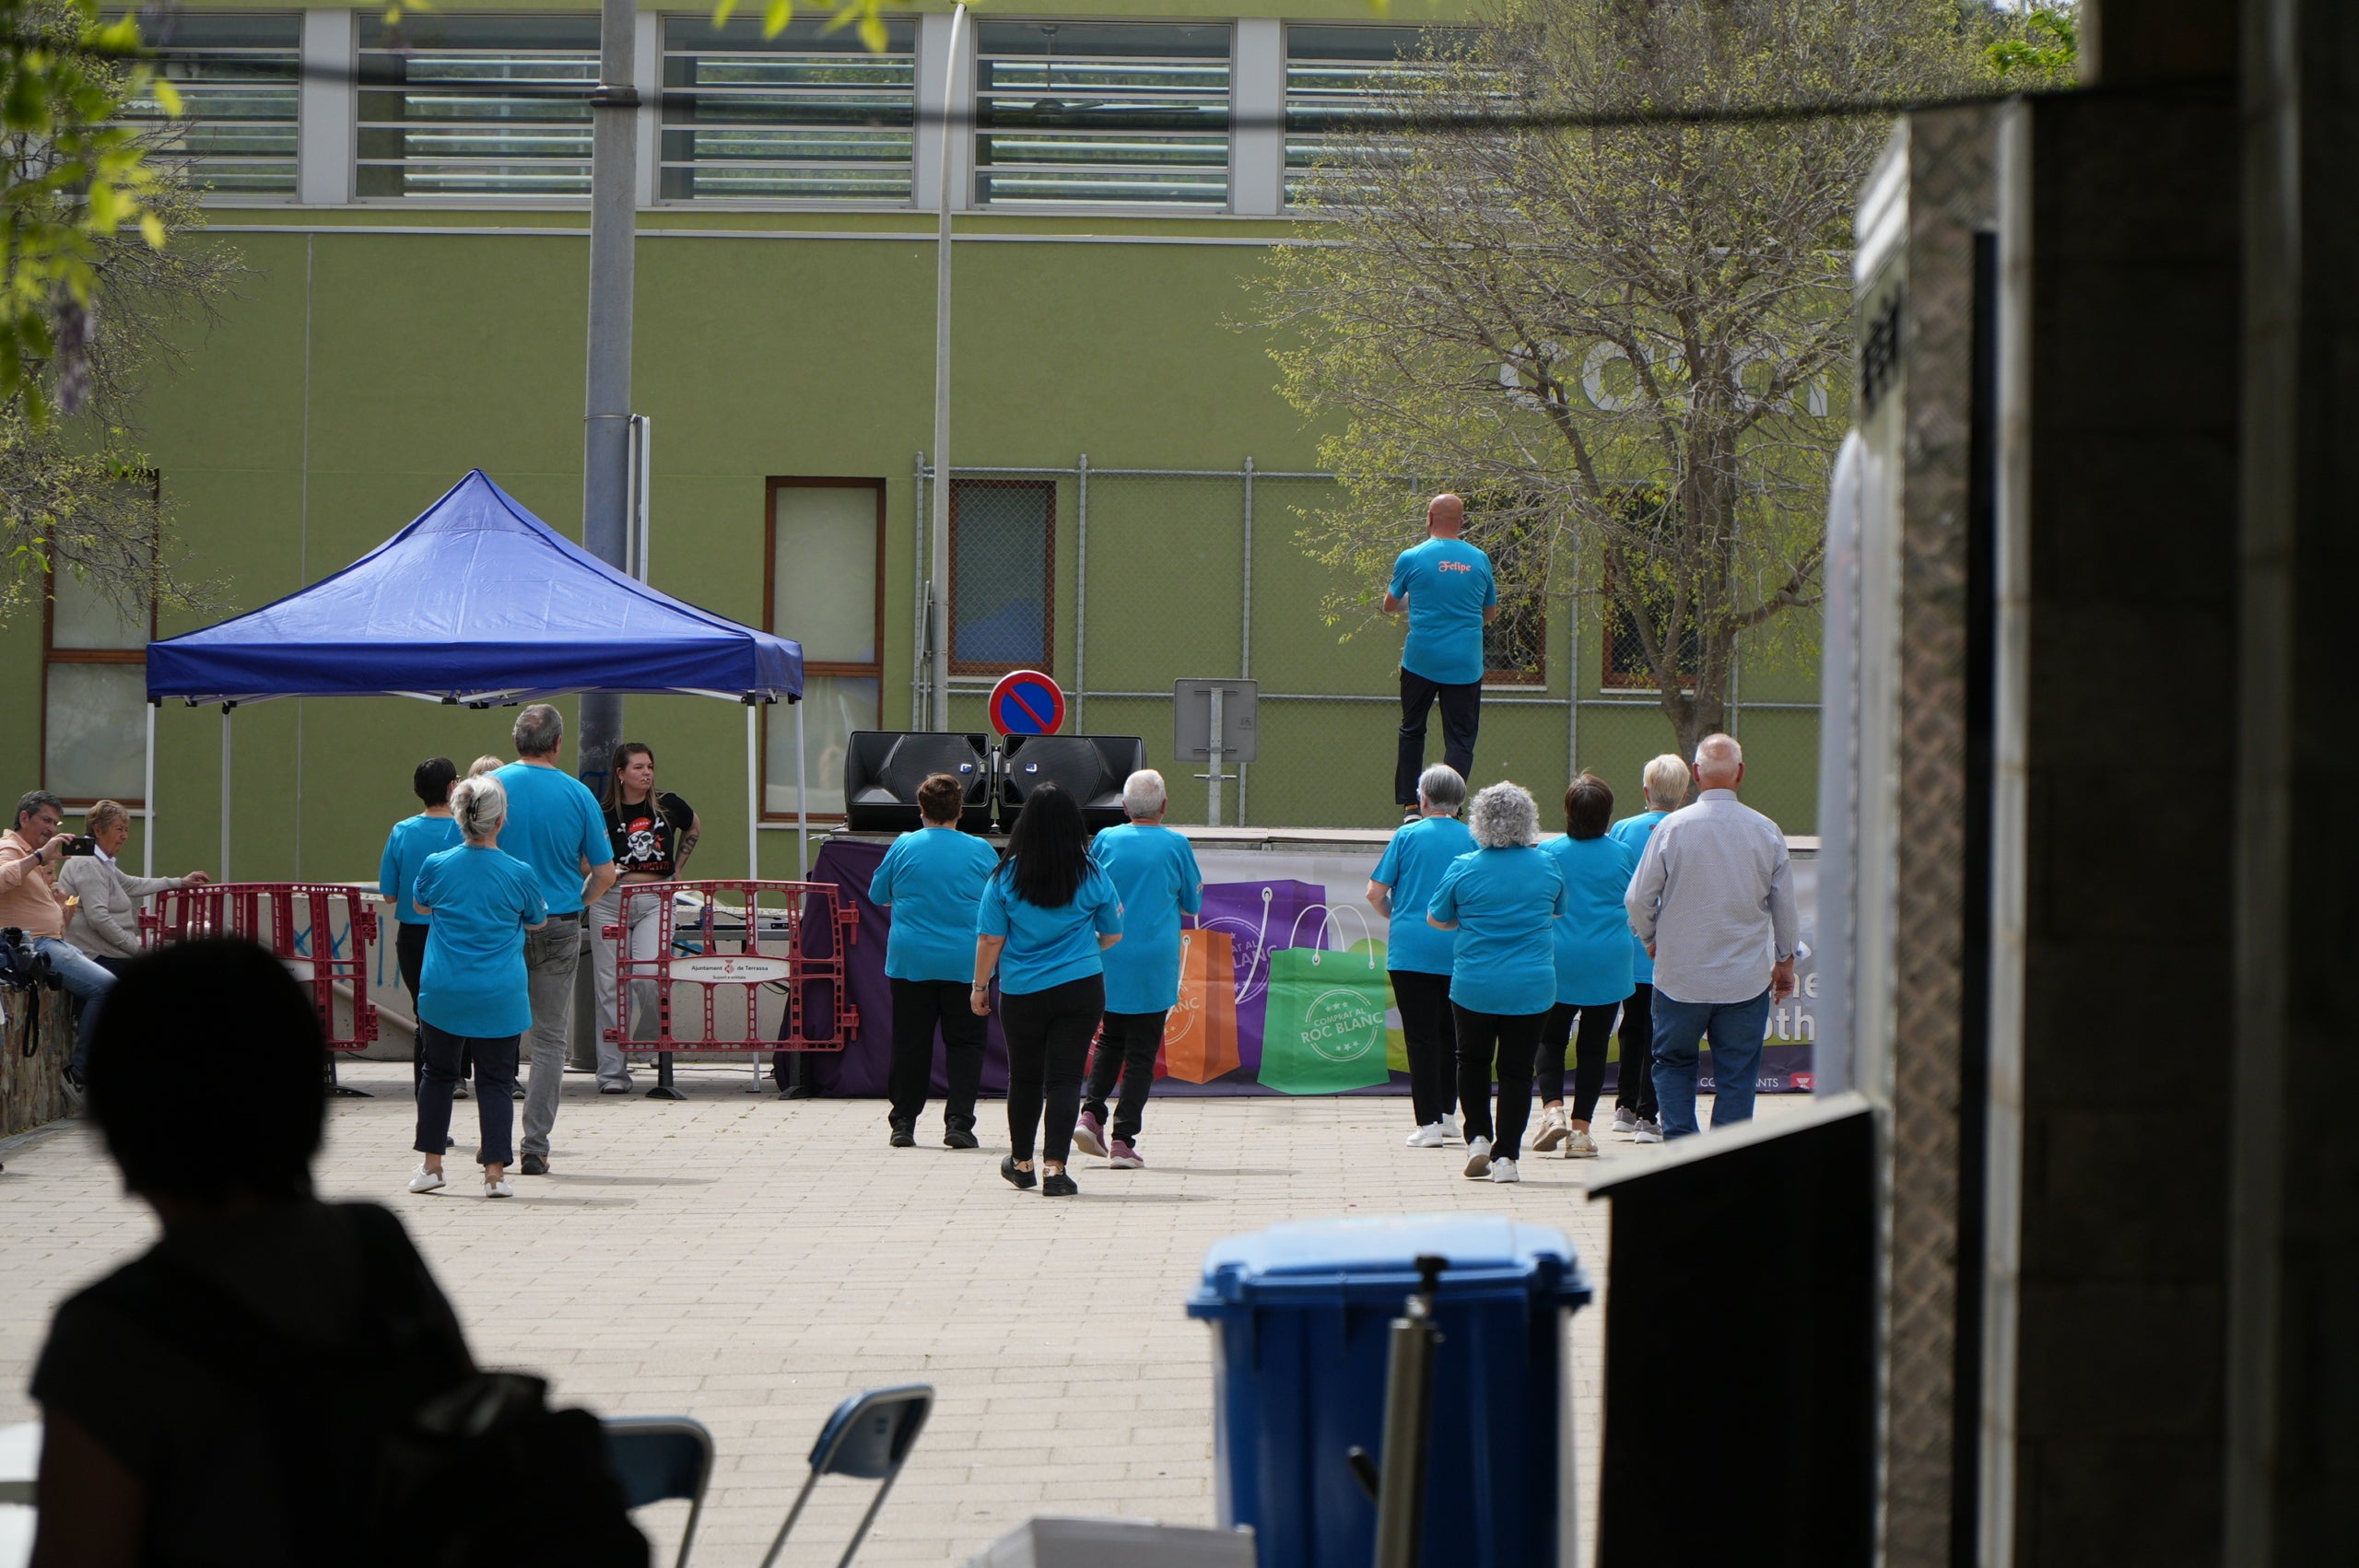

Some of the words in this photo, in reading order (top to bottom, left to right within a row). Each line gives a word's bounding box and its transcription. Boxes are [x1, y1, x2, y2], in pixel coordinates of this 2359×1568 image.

[1438, 560, 1472, 575] Felipe
[1313, 1010, 1354, 1027] COMPRAT
[1300, 1025, 1332, 1044] ROC
[1334, 1012, 1384, 1035] BLANC
